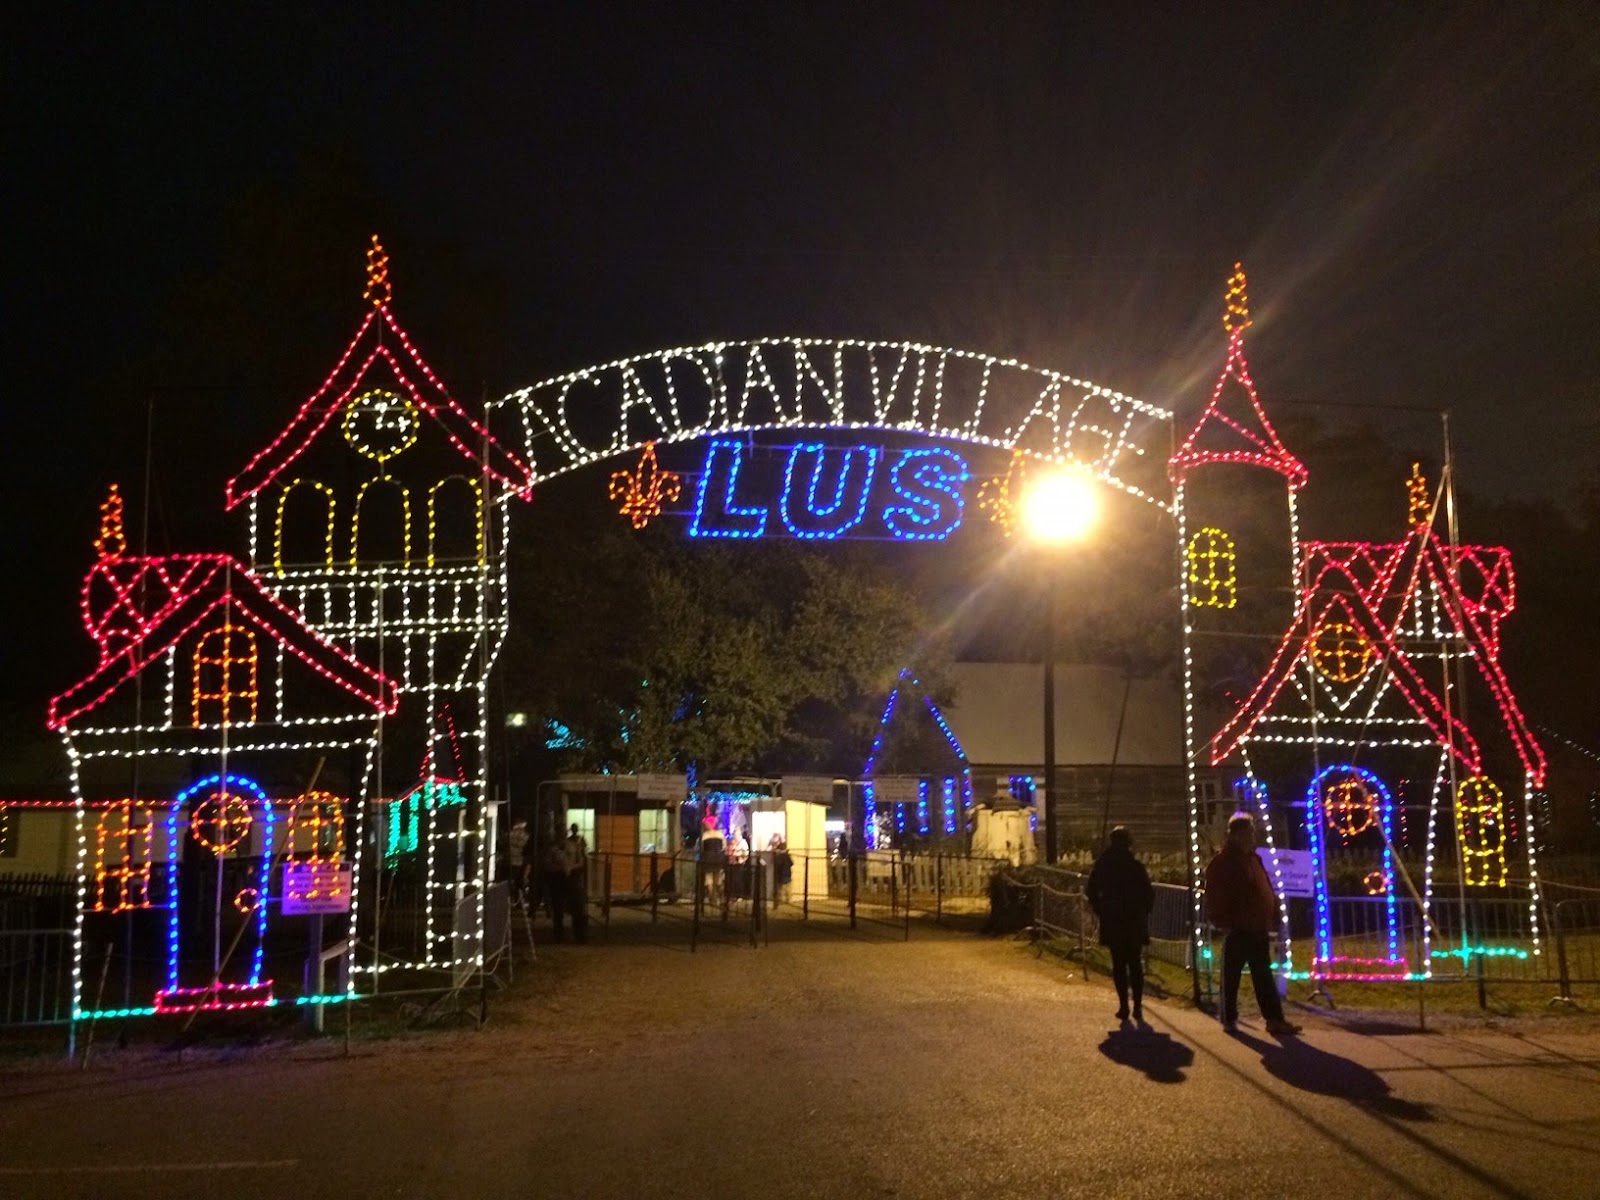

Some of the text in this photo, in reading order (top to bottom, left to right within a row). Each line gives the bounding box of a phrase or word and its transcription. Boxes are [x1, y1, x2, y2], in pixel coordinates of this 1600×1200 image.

[518, 339, 1164, 486] ACADIAN VILLAGE
[686, 438, 970, 541] LUS
